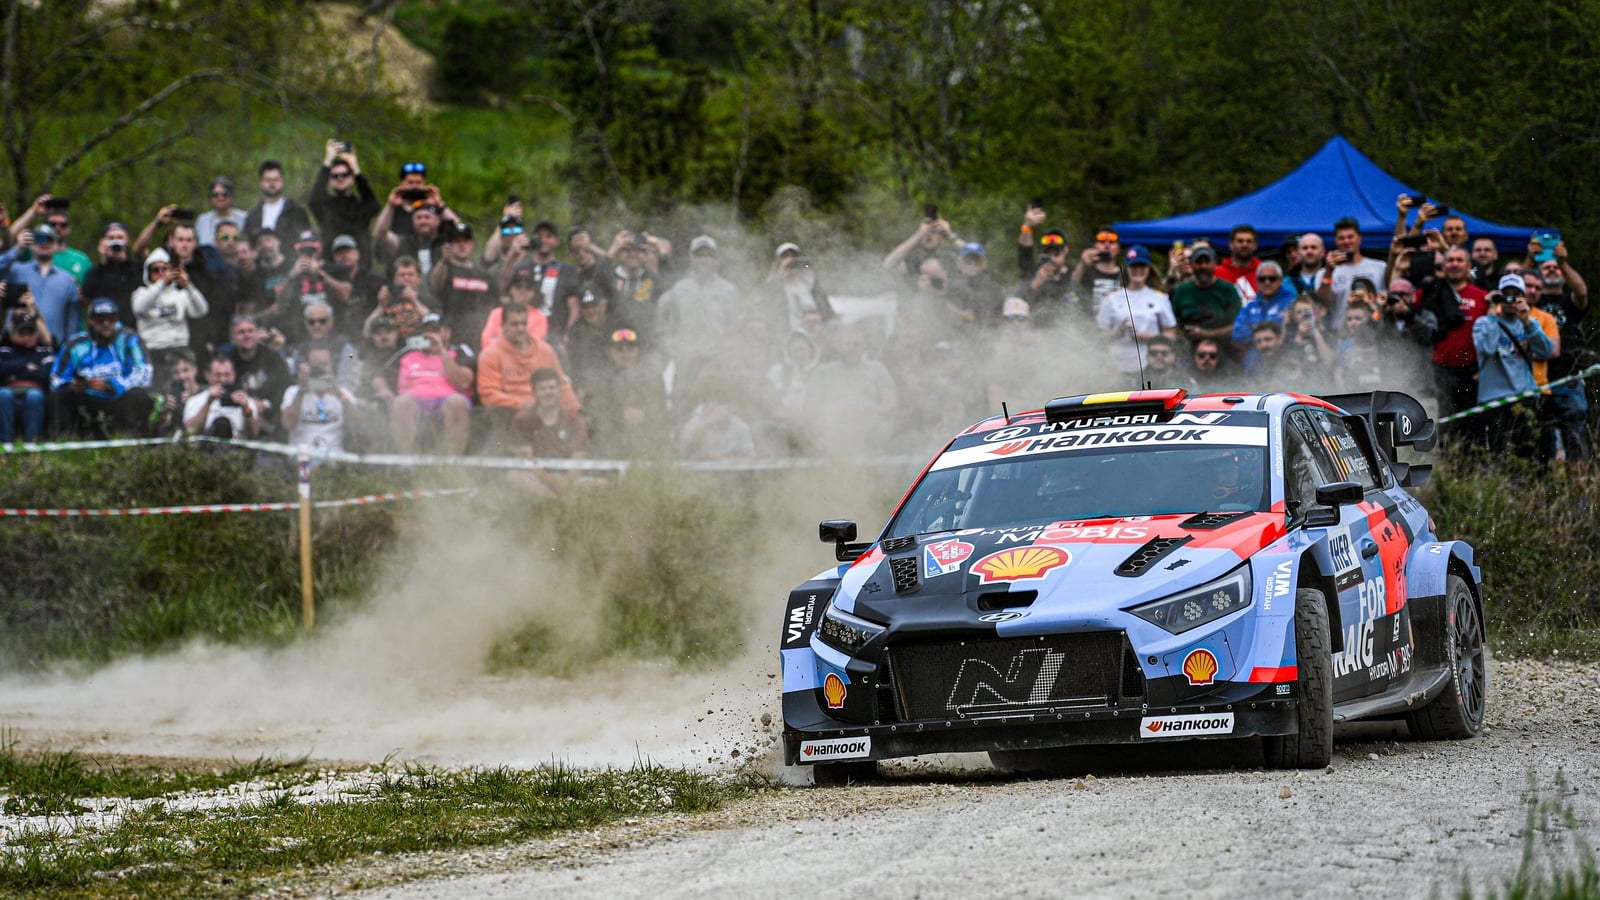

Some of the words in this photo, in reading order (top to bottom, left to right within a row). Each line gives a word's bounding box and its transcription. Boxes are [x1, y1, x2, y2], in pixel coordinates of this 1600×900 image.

[1039, 414, 1158, 433] HYUNDAI
[995, 526, 1149, 545] MOBIS
[1263, 576, 1274, 610] HYUNDAI
[1358, 576, 1387, 624] FOR
[804, 594, 817, 625] HYUNDAI
[1368, 660, 1389, 681] HYUNDAI
